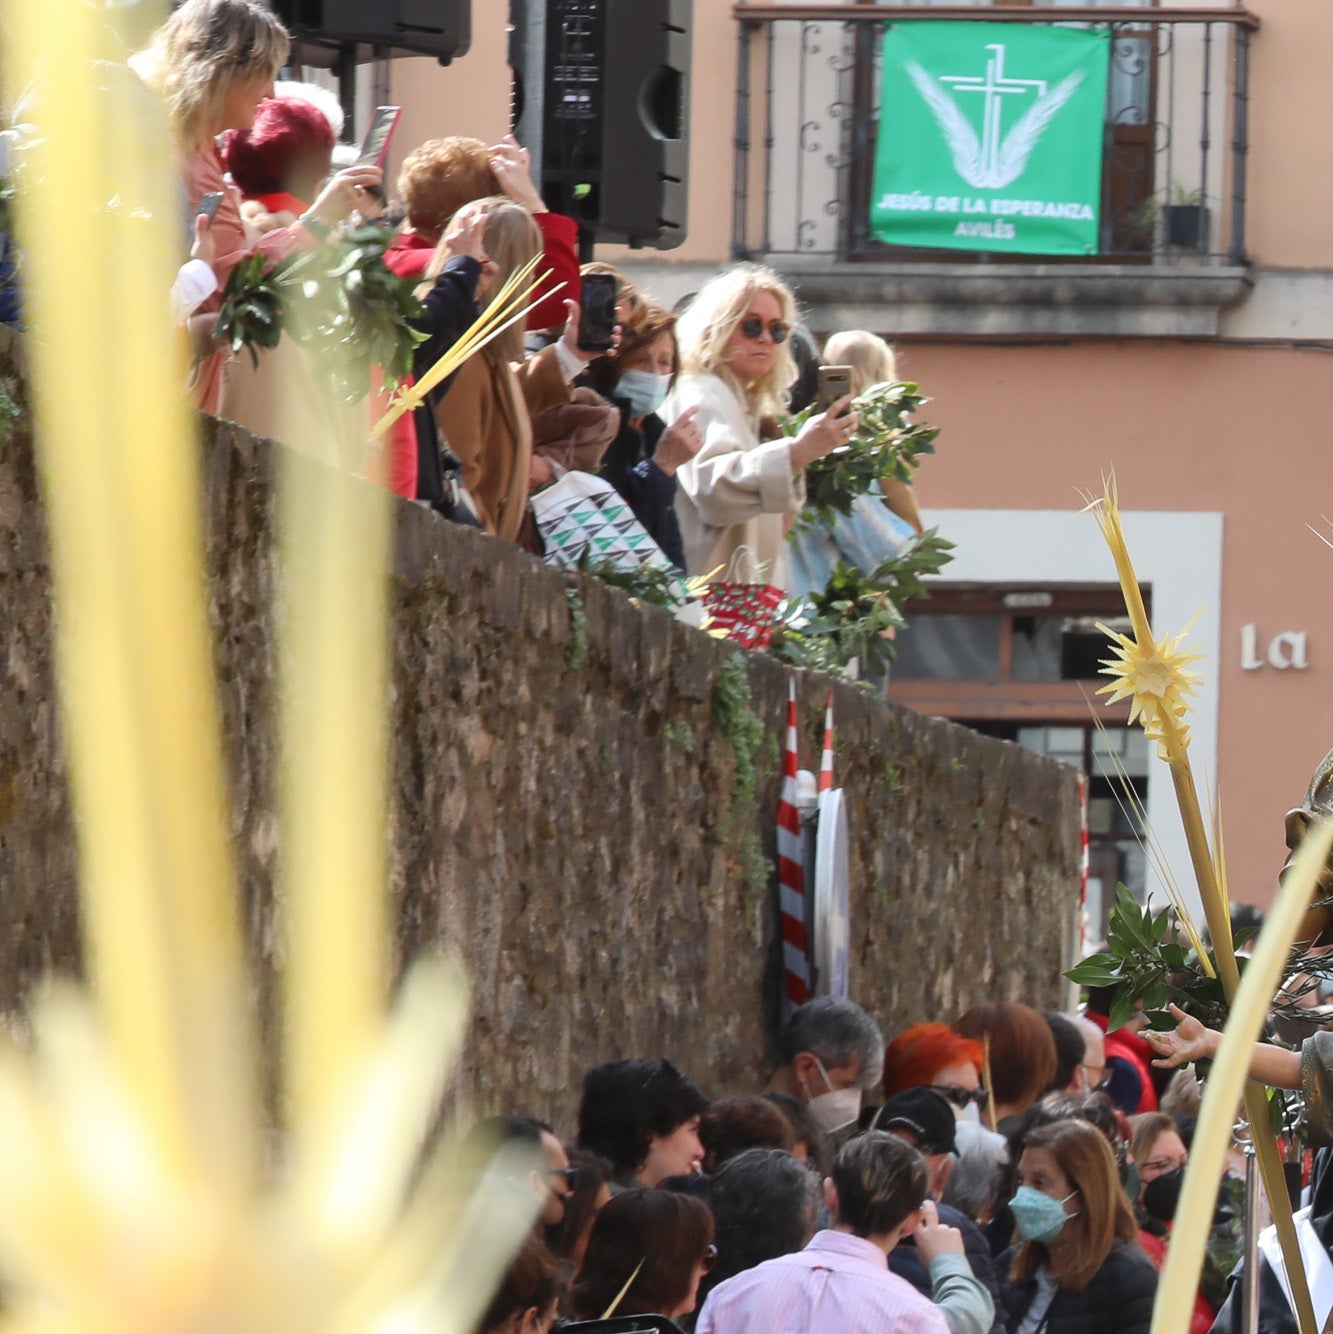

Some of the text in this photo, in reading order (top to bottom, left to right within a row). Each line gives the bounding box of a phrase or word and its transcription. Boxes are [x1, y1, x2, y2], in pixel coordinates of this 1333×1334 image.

[878, 191, 1093, 218] JESÚS DE LA ESPERANZA
[954, 219, 1015, 239] AVILÉS
[1239, 623, 1309, 670] la
